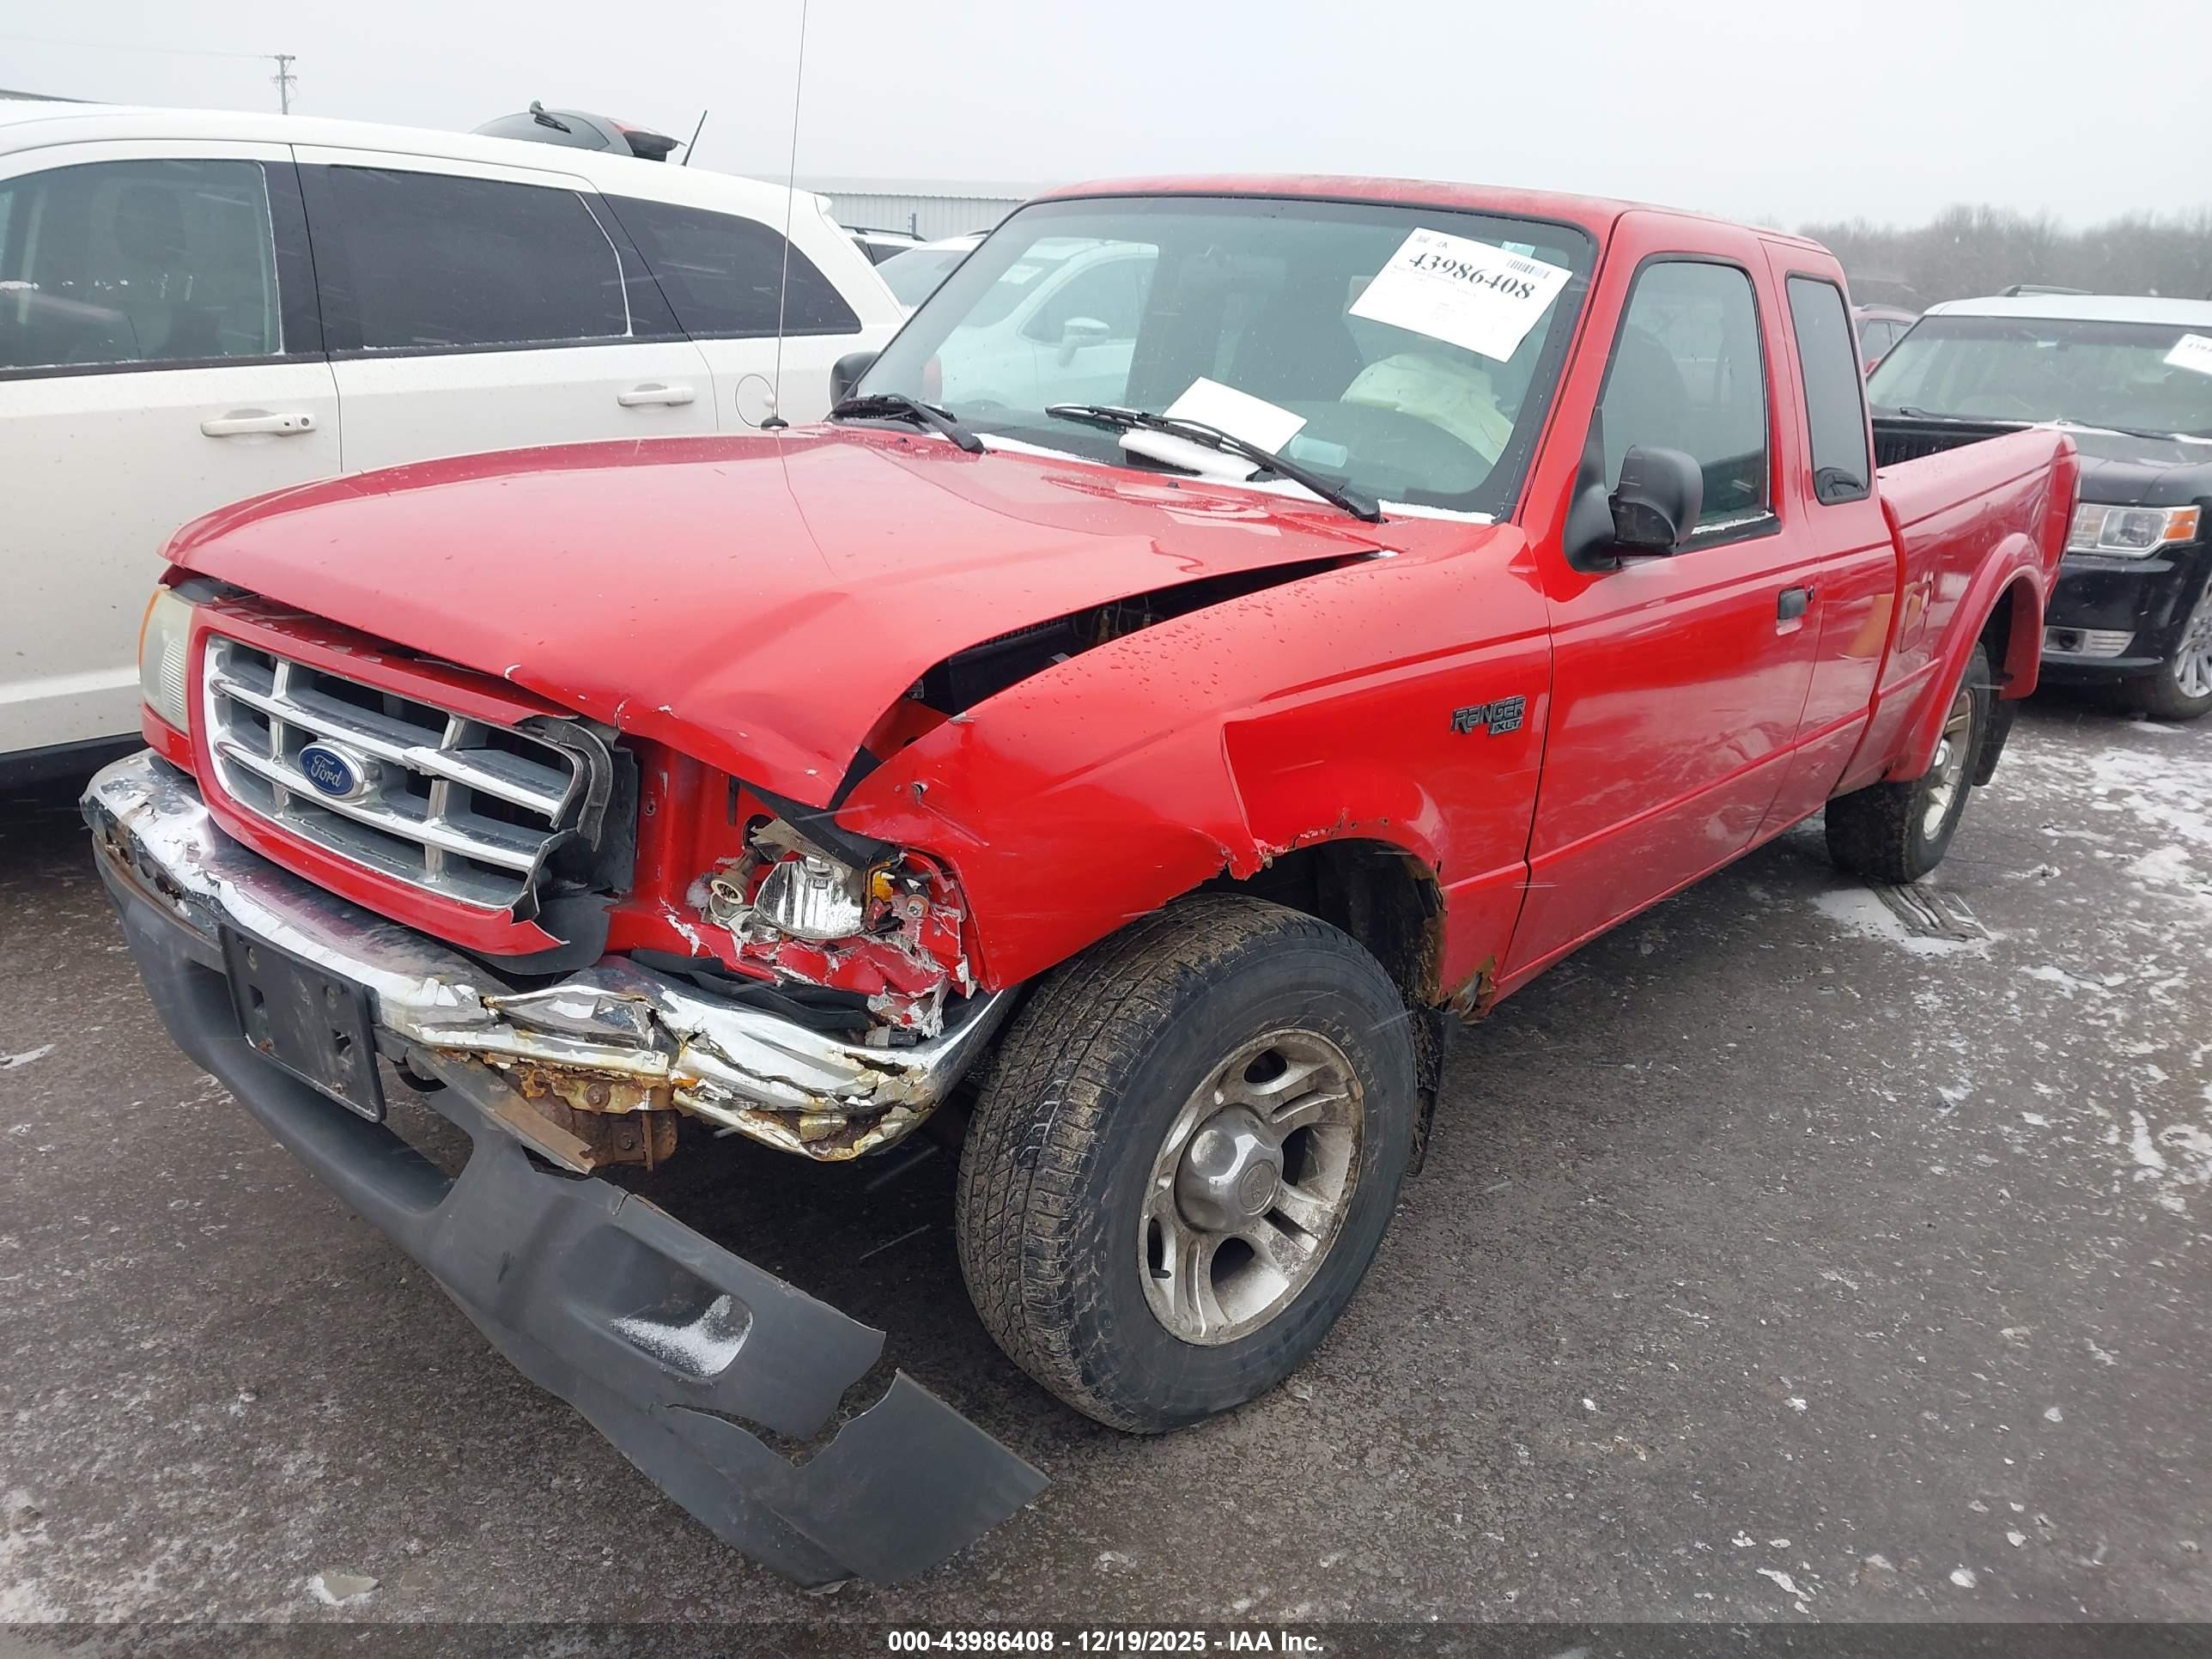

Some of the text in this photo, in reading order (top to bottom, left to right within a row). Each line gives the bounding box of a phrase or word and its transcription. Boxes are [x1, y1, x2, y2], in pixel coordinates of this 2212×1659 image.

[1409, 252, 1535, 300] 43986408
[1449, 695, 1526, 734] RANGER
[1493, 719, 1521, 732] XLT
[310, 755, 343, 787] Ford
